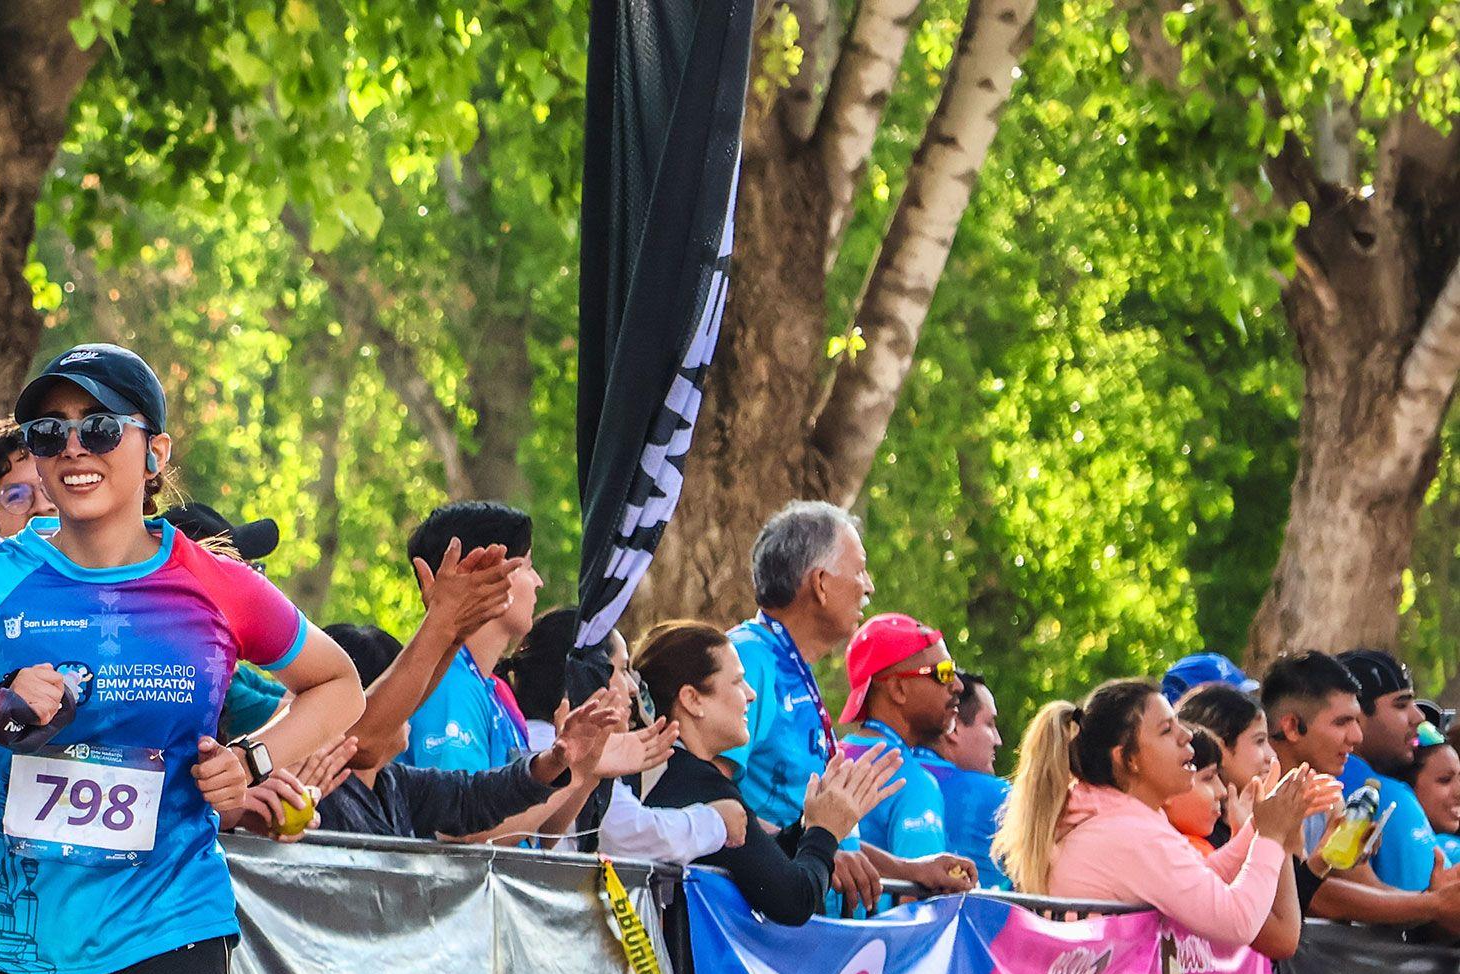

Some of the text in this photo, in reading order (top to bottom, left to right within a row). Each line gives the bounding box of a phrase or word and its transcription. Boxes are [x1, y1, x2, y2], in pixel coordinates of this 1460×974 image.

[23, 620, 40, 628] San
[41, 618, 59, 627] Luis
[97, 664, 196, 678] ANIVERSARIO
[96, 677, 195, 691] BMW MARATÓN
[96, 690, 193, 704] TANGAMANGA
[34, 773, 139, 831] 798
